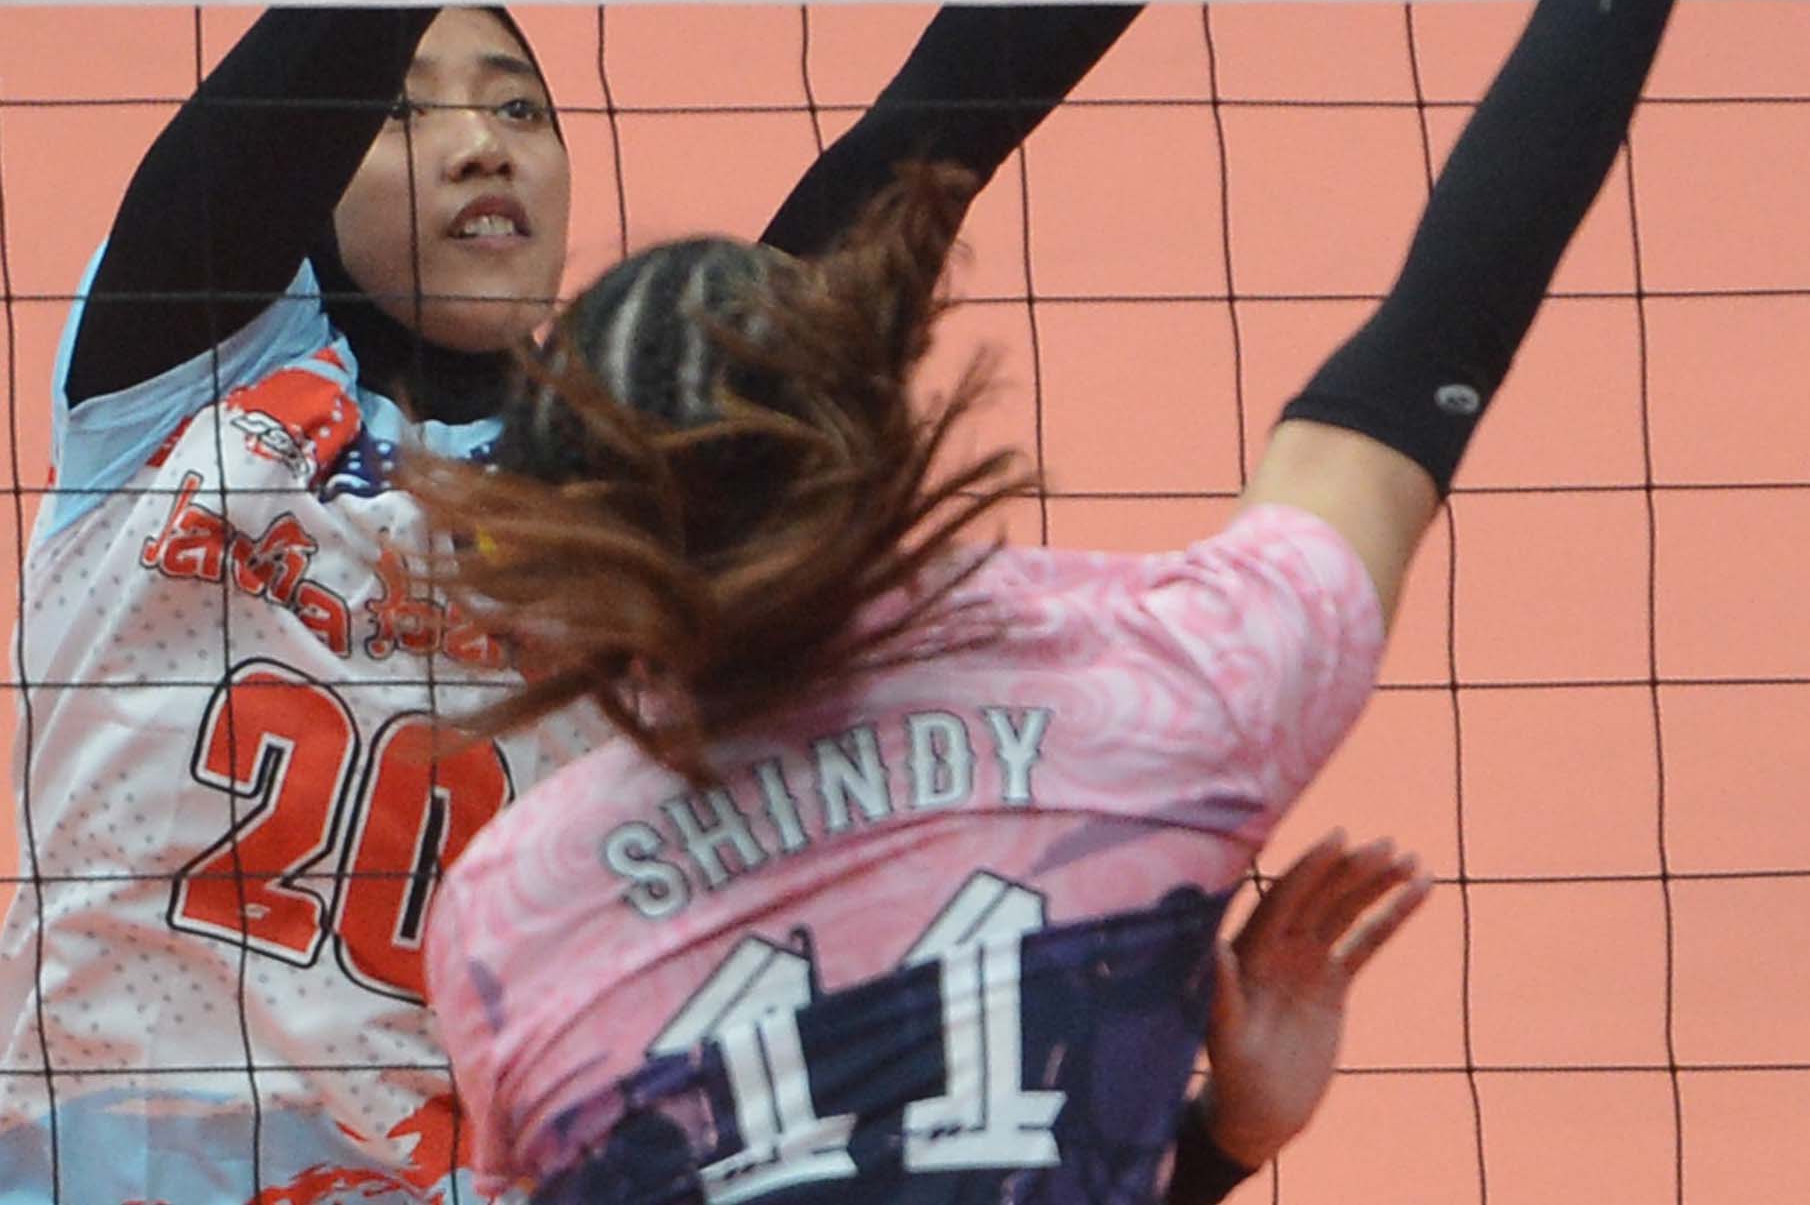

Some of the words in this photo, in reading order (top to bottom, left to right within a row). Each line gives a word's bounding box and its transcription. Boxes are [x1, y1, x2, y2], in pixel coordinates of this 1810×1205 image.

[167, 656, 514, 1005] 20
[604, 706, 1054, 921] SHINDY
[646, 868, 1066, 1205] 11
